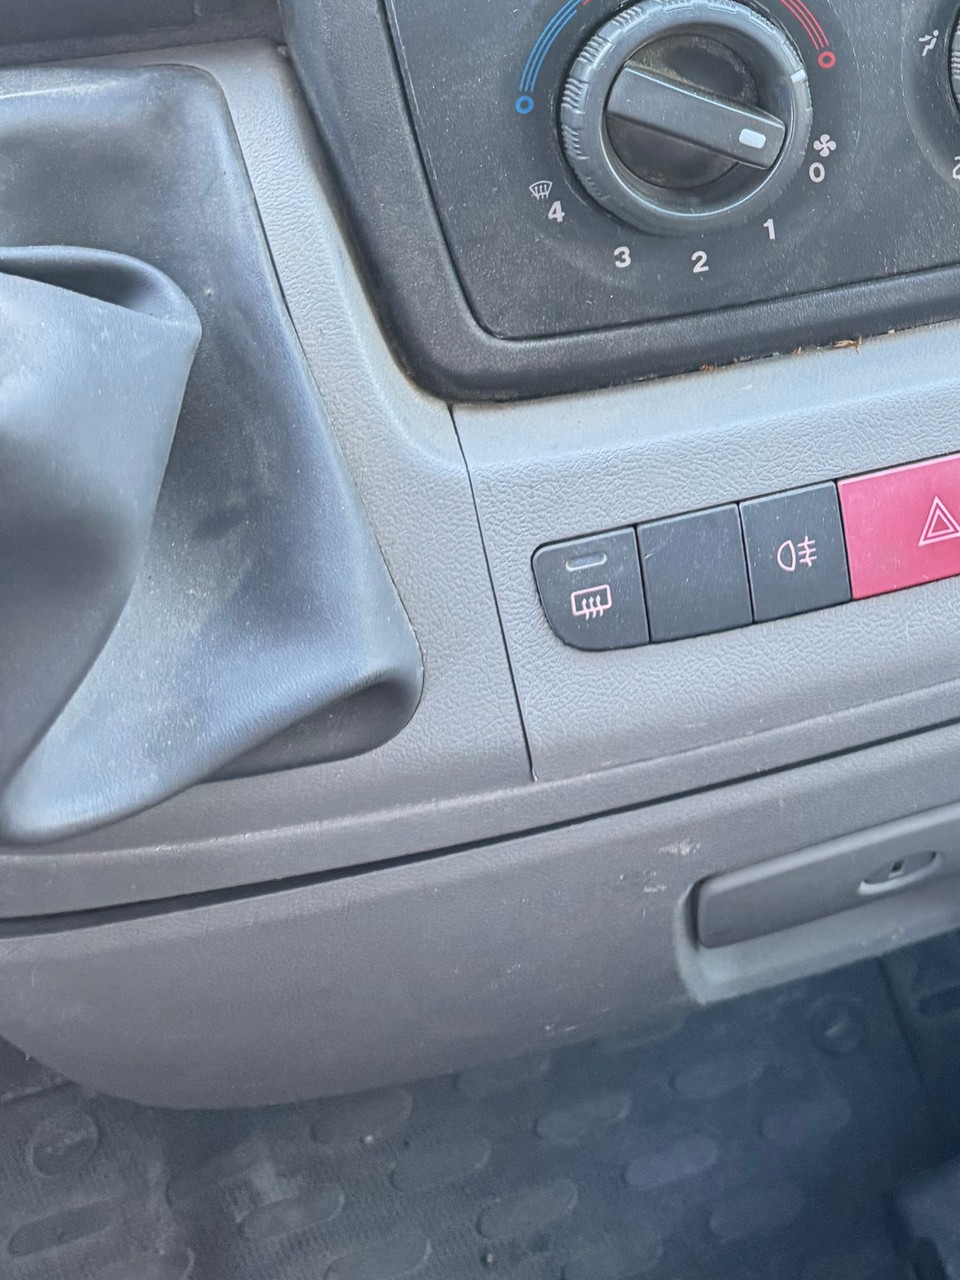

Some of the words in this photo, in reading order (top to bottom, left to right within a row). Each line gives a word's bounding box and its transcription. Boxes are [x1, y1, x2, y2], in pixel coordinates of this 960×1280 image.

[808, 161, 826, 183] 0
[547, 200, 566, 223] 4
[762, 218, 776, 240] 1
[613, 246, 632, 269] 3
[690, 250, 710, 273] 2
